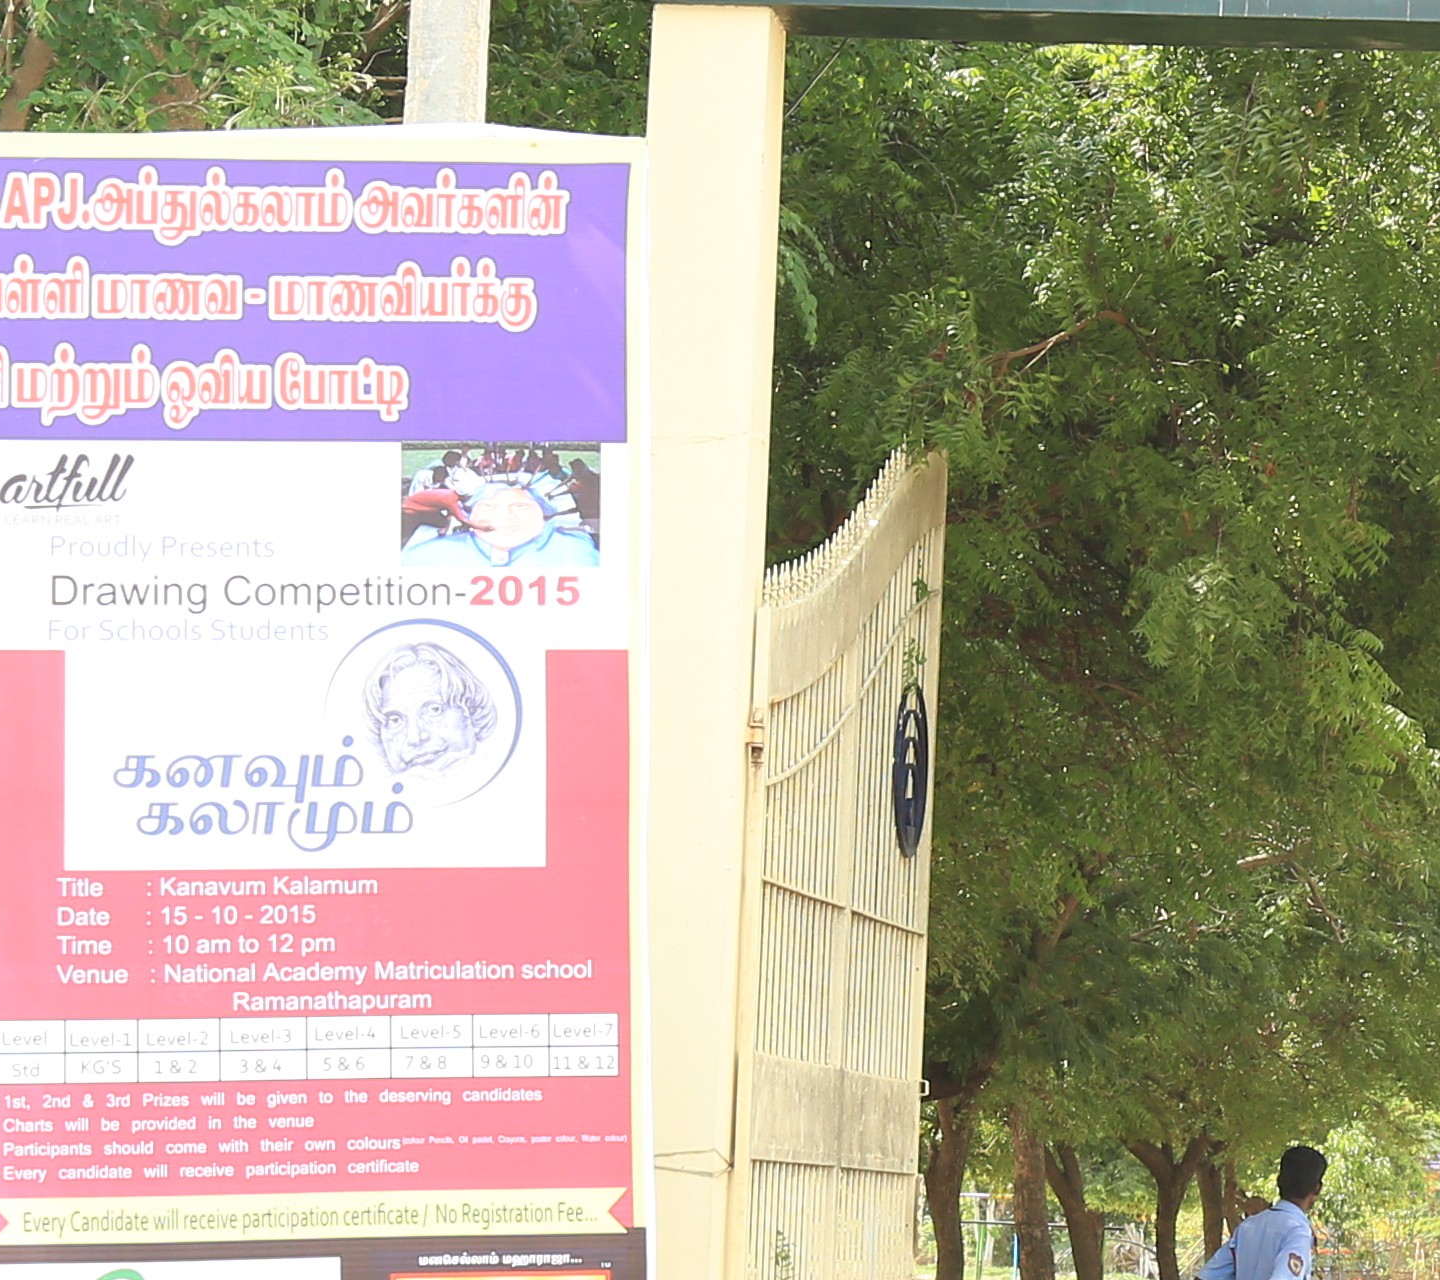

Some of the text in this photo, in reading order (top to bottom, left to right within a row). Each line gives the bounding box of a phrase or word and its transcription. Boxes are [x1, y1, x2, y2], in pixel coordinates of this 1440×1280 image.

[356, 168, 568, 235] அவர்களின்
[94, 275, 242, 320] மாணவ
[245, 288, 266, 304] -
[270, 257, 537, 331] மாணவியர்க்கு
[11, 344, 159, 425] மற்றும்
[275, 352, 408, 420] போட்டி
[0, 454, 134, 511] artfull
[51, 575, 580, 613] Drawing Competition-2015
[113, 735, 363, 802] கனவும்
[137, 782, 414, 852] கலாமும்
[57, 875, 378, 898] Title Kanavum Kalamum
[23, 1211, 66, 1238] Every
[71, 1210, 149, 1233] Candidate
[153, 1209, 179, 1230] will
[183, 1211, 238, 1230] receive
[242, 1205, 339, 1235] participation
[343, 1203, 419, 1226] certificate
[436, 1204, 457, 1224] No
[463, 1204, 552, 1230] Registration
